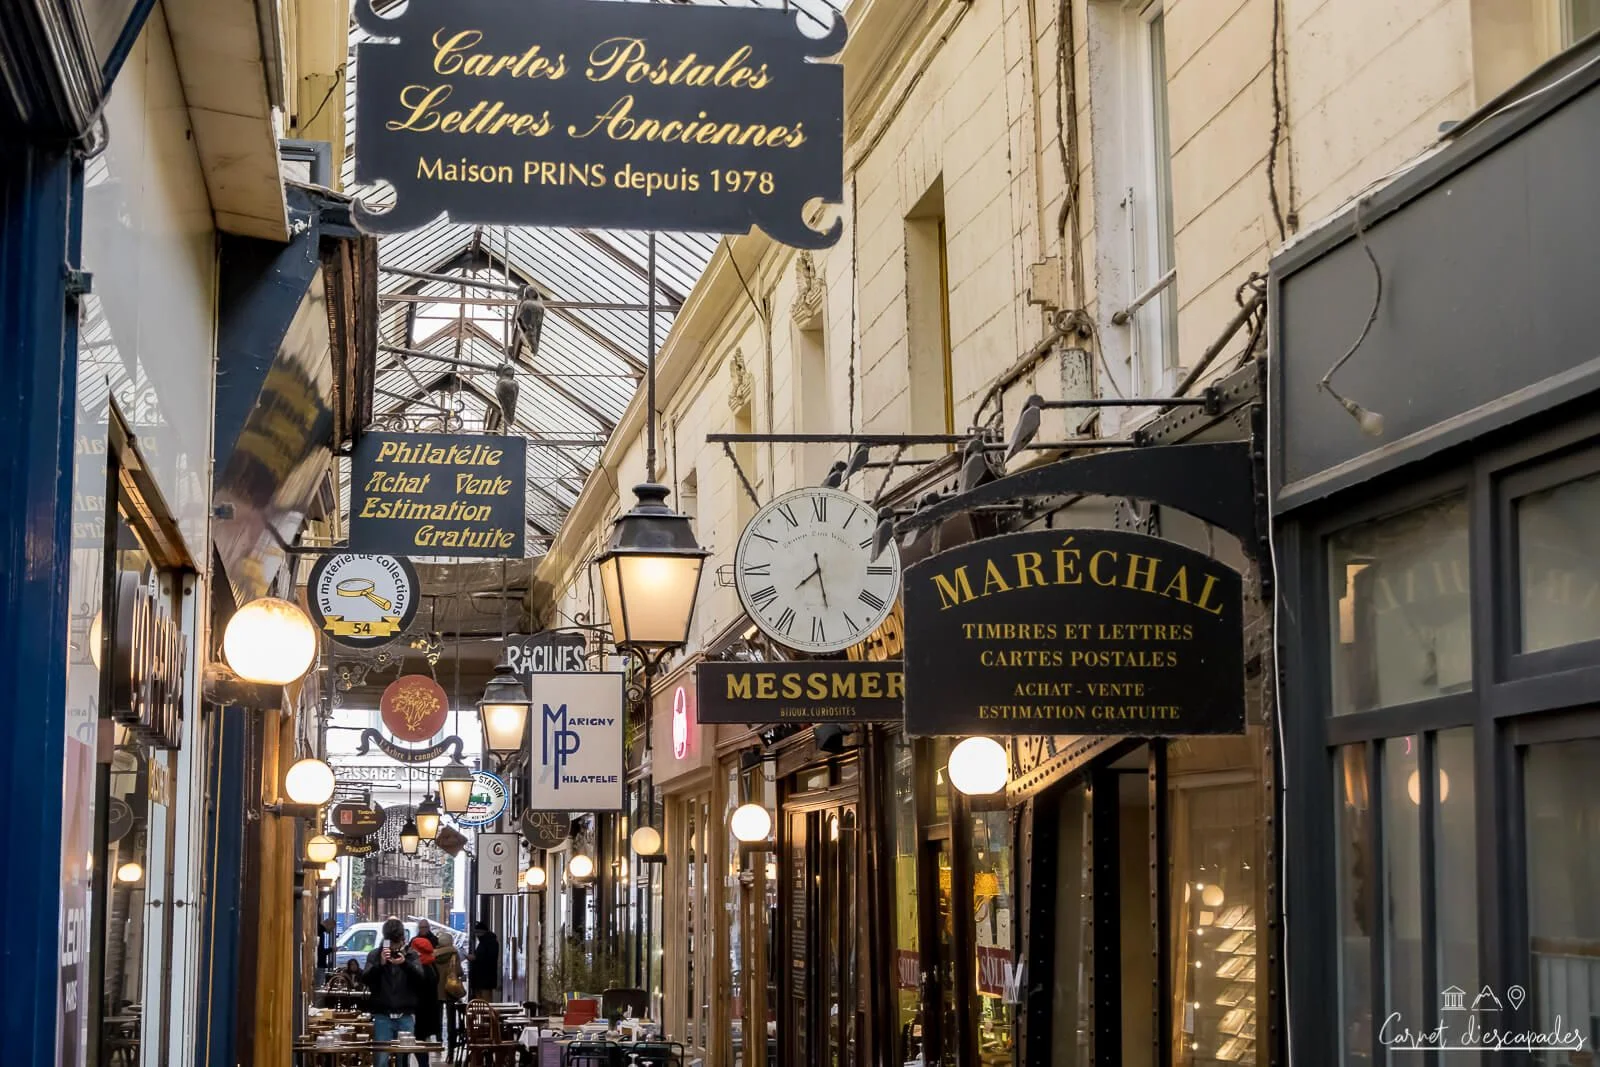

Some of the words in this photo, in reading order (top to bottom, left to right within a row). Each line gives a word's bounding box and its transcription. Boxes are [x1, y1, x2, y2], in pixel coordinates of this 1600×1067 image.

[432, 27, 567, 80] Cartes
[586, 37, 774, 89] Postales
[386, 84, 553, 137] Lettres
[568, 95, 807, 148] Anciennes
[417, 156, 513, 184] Maison
[524, 161, 606, 187] PRINS
[615, 163, 700, 196] depuis
[710, 170, 775, 194] 1978
[375, 441, 503, 466] Philatélie
[364, 471, 431, 494] Achat
[456, 473, 512, 495] Vente
[359, 497, 492, 521] Estimation
[414, 525, 515, 548] Gratuite
[321, 598, 332, 613] au
[376, 556, 407, 616] collections
[929, 536, 1224, 615] MARÉCHAL
[353, 623, 370, 634] 54
[962, 623, 1057, 640] TIMBRES
[1065, 624, 1091, 640] ET
[1099, 624, 1193, 640] LETTRES
[507, 645, 585, 674] RACINES
[980, 651, 1063, 667] CARTES
[1071, 651, 1178, 667] POSTALES
[726, 672, 904, 700] MESSMER
[1013, 682, 1073, 697] ACHAT
[1087, 683, 1145, 697] VENTE
[979, 705, 1086, 720] ESTIMATION
[1092, 705, 1180, 720] GRATUITE
[479, 776, 504, 798] STATION
